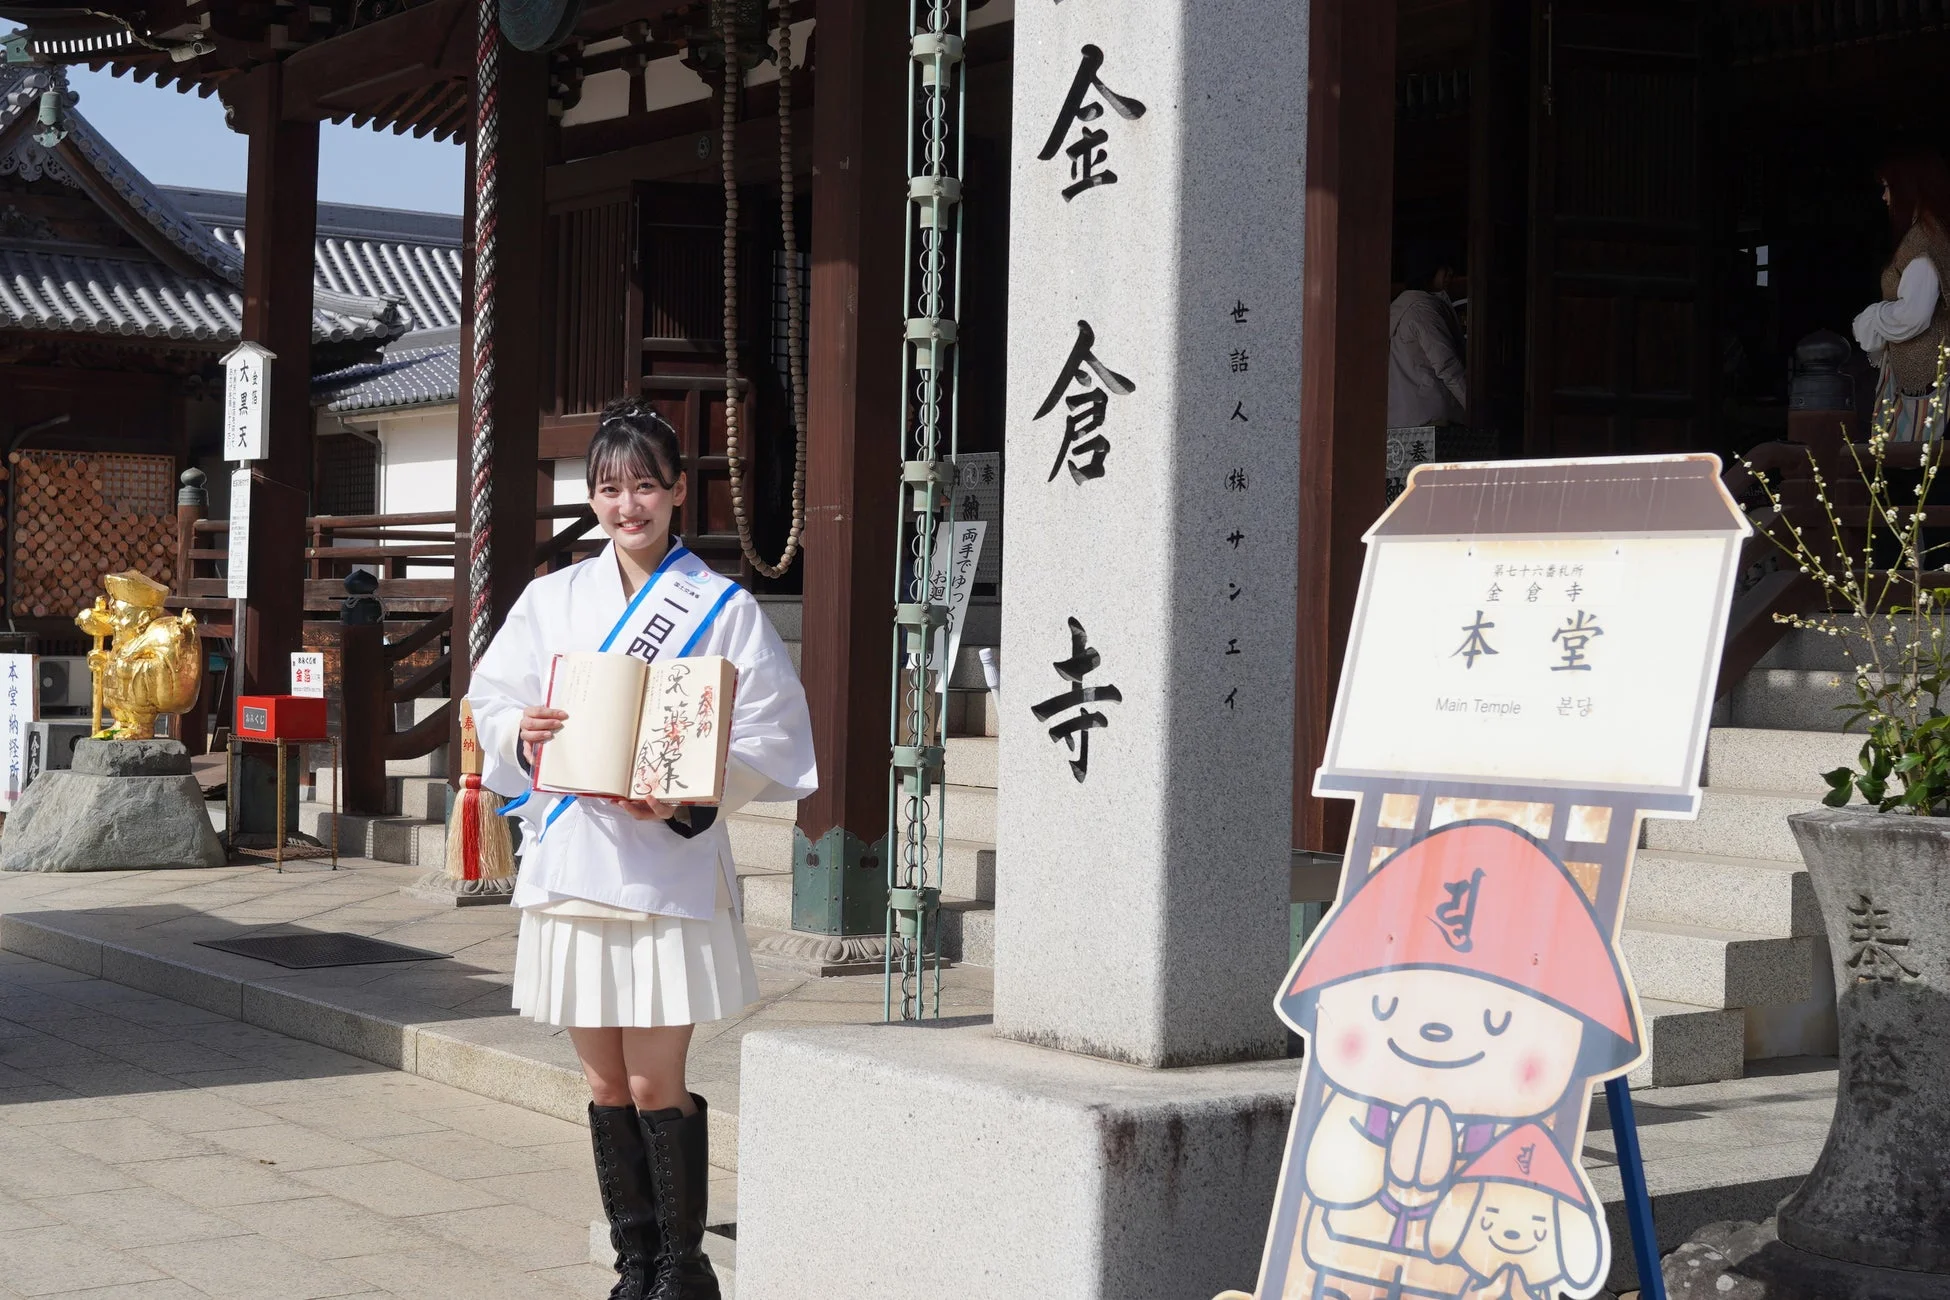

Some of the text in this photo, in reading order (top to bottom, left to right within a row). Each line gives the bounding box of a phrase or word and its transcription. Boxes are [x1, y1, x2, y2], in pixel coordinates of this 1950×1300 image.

[1031, 43, 1147, 784] 金倉寺
[1494, 564, 1584, 578] 第七十六番札所
[1486, 581, 1583, 602] 金倉寺
[1449, 610, 1604, 671] 本堂
[1435, 697, 1522, 716] Main Temple
[1557, 696, 1593, 717] 본당
[463, 715, 475, 753] 奉納
